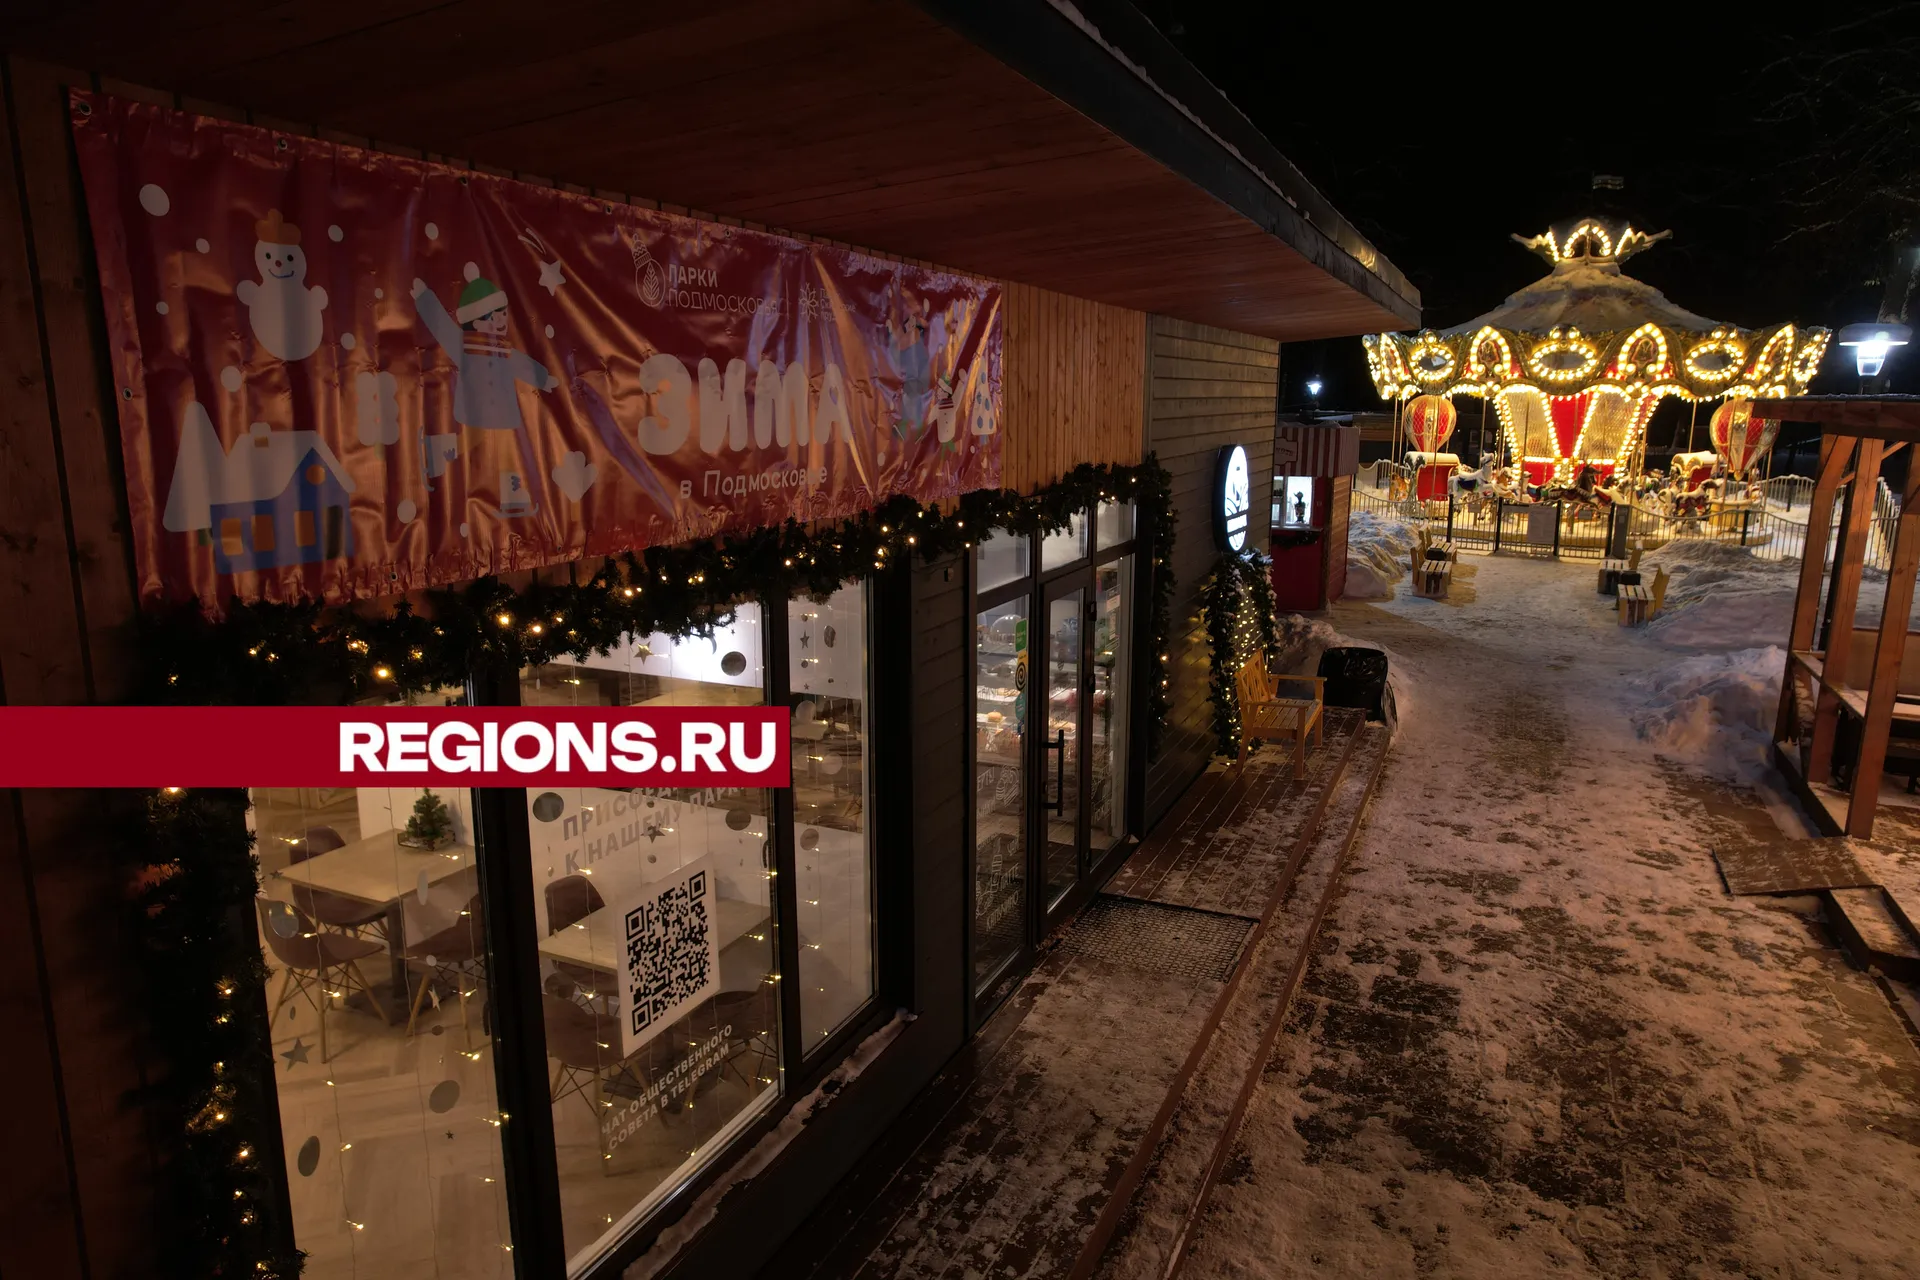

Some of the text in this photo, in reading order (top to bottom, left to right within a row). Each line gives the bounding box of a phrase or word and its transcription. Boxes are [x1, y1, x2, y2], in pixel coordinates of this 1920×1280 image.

[668, 263, 718, 288] ПАРКИ
[638, 353, 853, 455] ЗИМА
[680, 466, 828, 500] в Подмоскове
[563, 787, 678, 841] ПРИСОЕД
[565, 787, 744, 875] К НАШЕМУ ПАРК
[602, 1024, 732, 1136] ЧАТ ОБЩЕСТВЕННОГО
[609, 1043, 730, 1150] СОВЕТА В TELEGRAM
